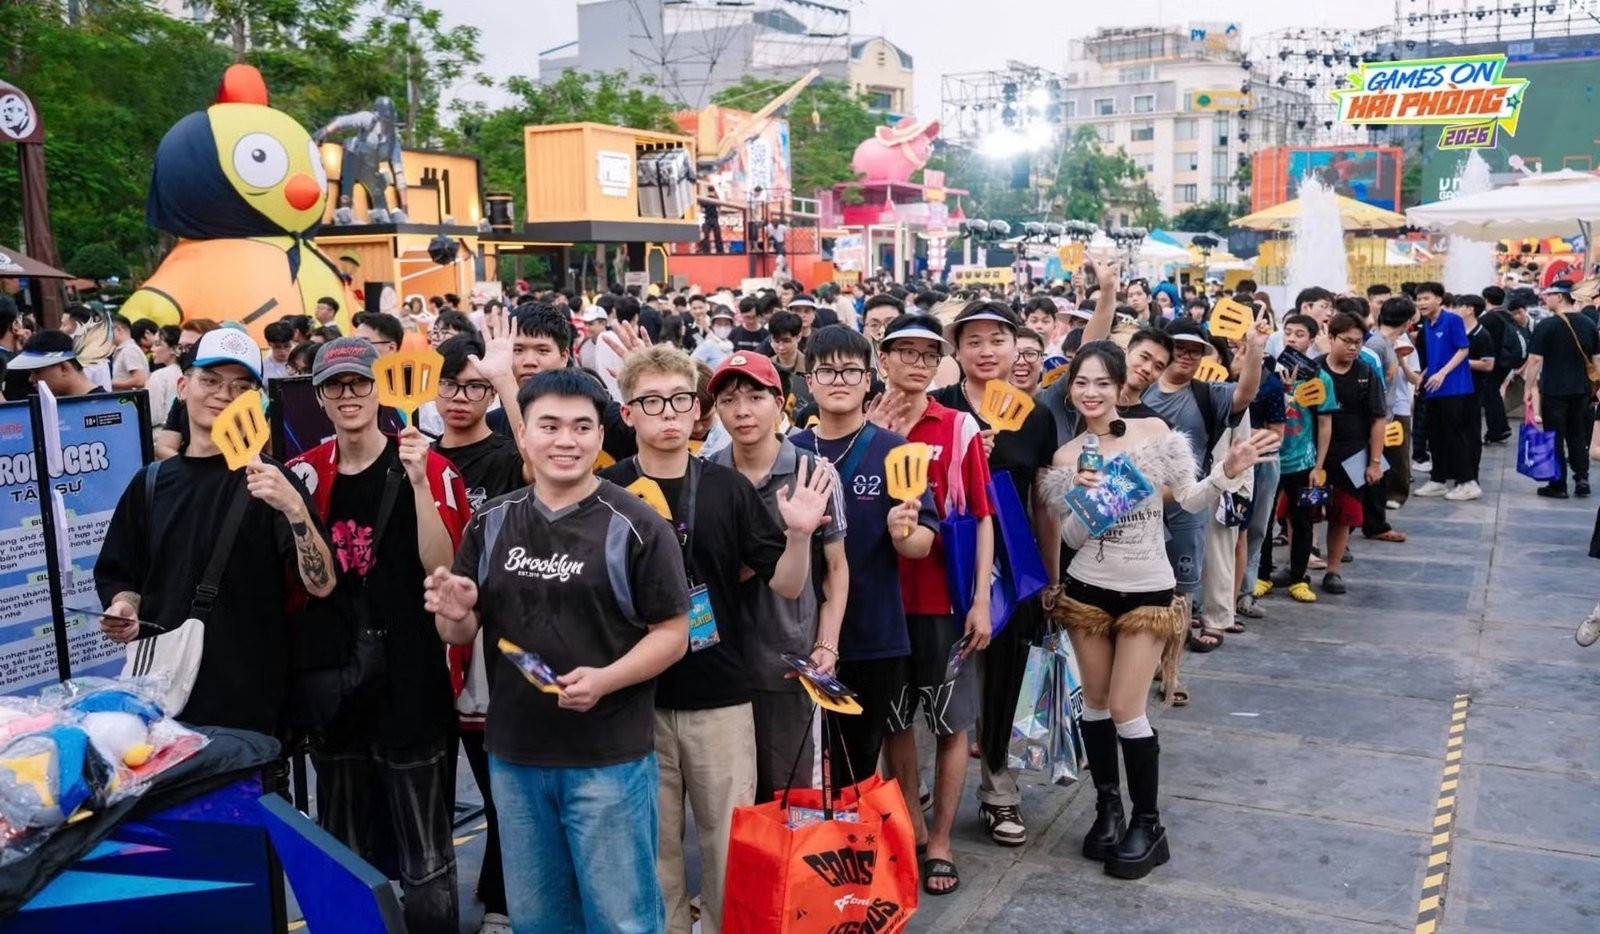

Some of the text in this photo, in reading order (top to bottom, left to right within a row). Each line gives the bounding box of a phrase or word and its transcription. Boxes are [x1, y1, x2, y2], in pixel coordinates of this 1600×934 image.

[853, 474, 881, 495] 02
[504, 547, 584, 582] Brooklyn
[802, 847, 879, 888] CROS
